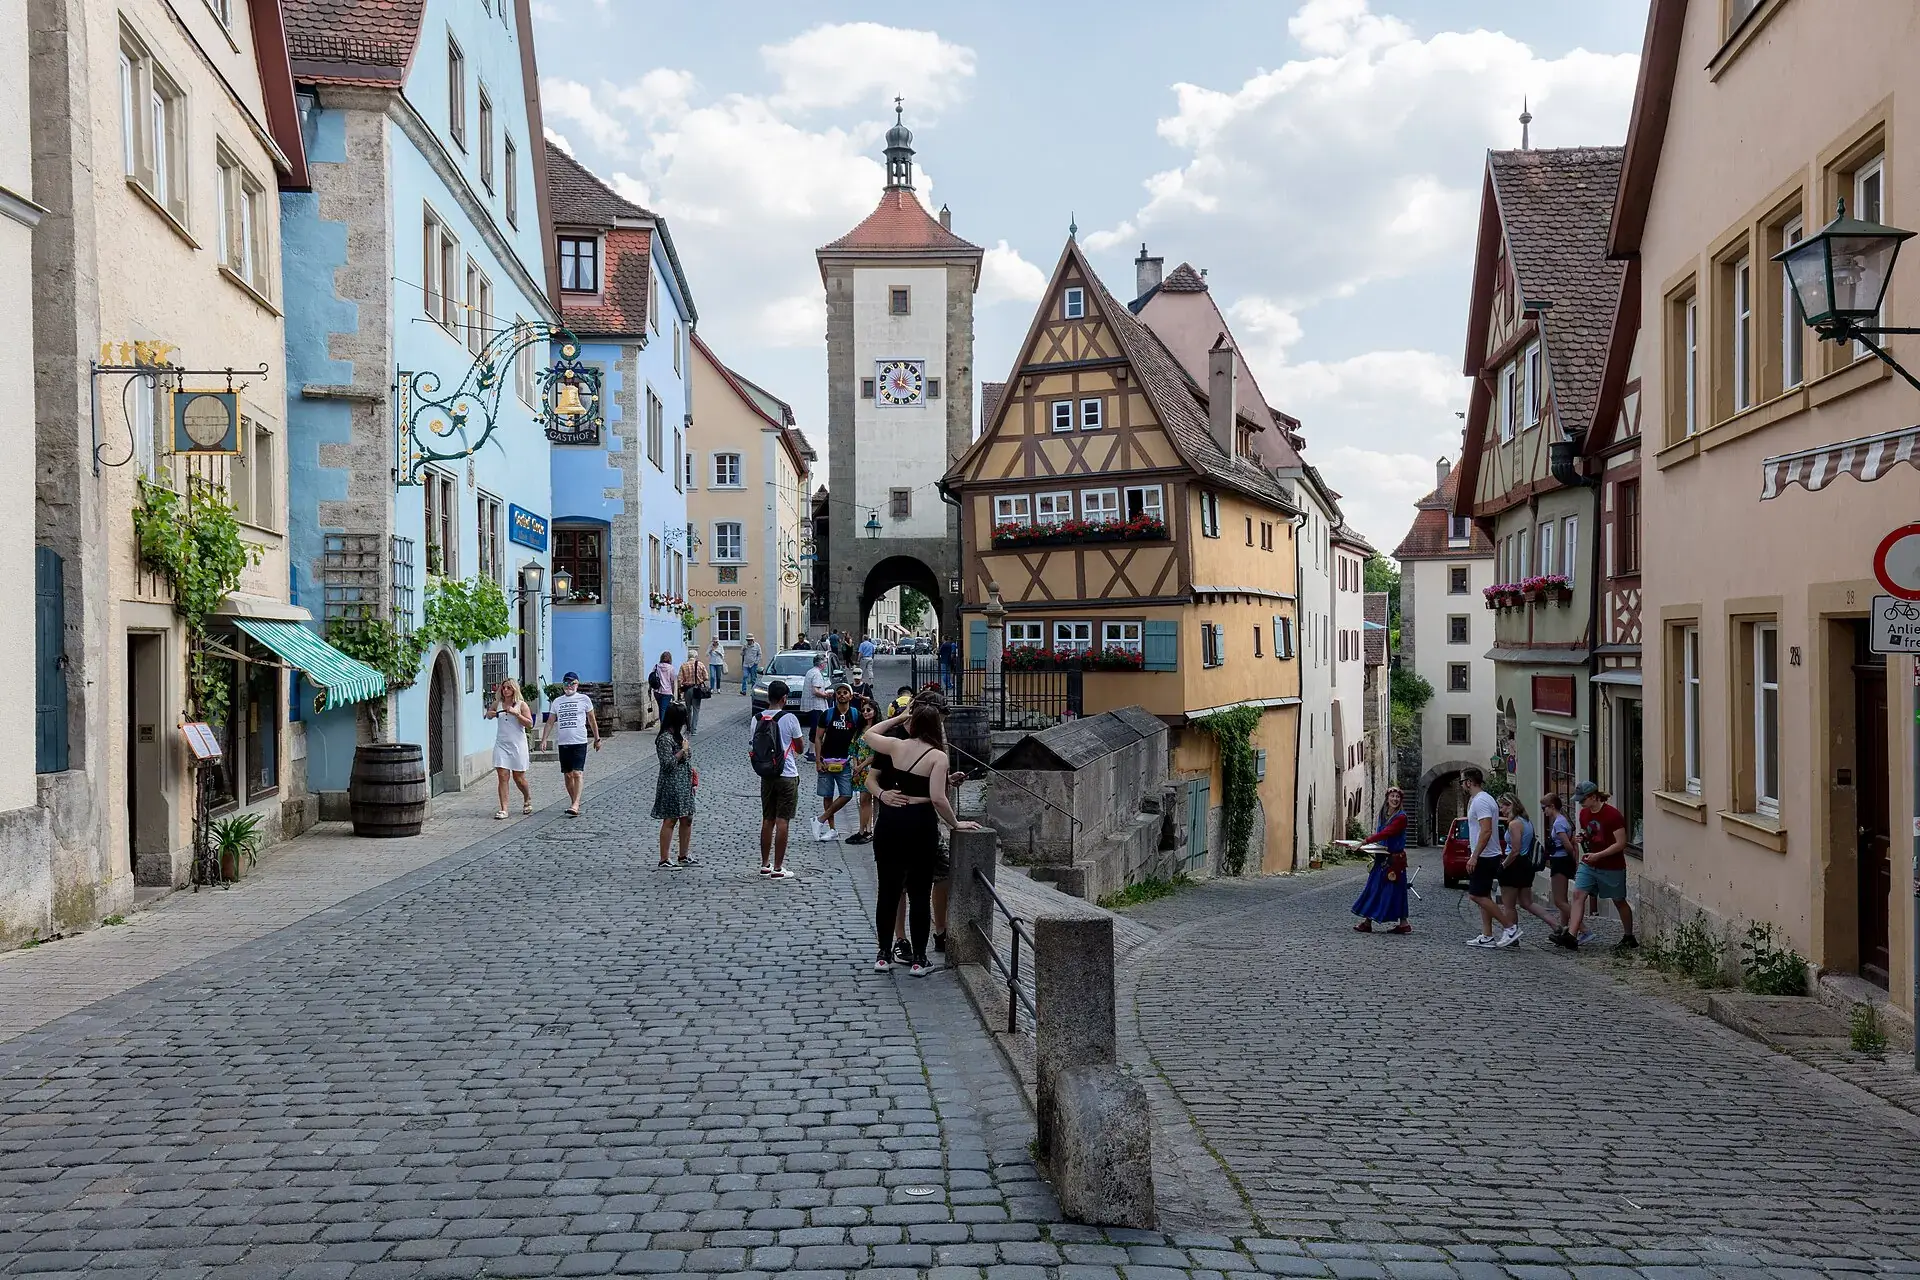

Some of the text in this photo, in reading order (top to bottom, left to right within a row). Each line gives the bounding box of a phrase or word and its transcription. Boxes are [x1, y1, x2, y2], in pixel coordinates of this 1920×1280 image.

[549, 430, 590, 441] GASTHOF
[688, 589, 747, 597] Chocolaterie
[1846, 590, 1855, 604] 28
[1789, 646, 1801, 666] 28
